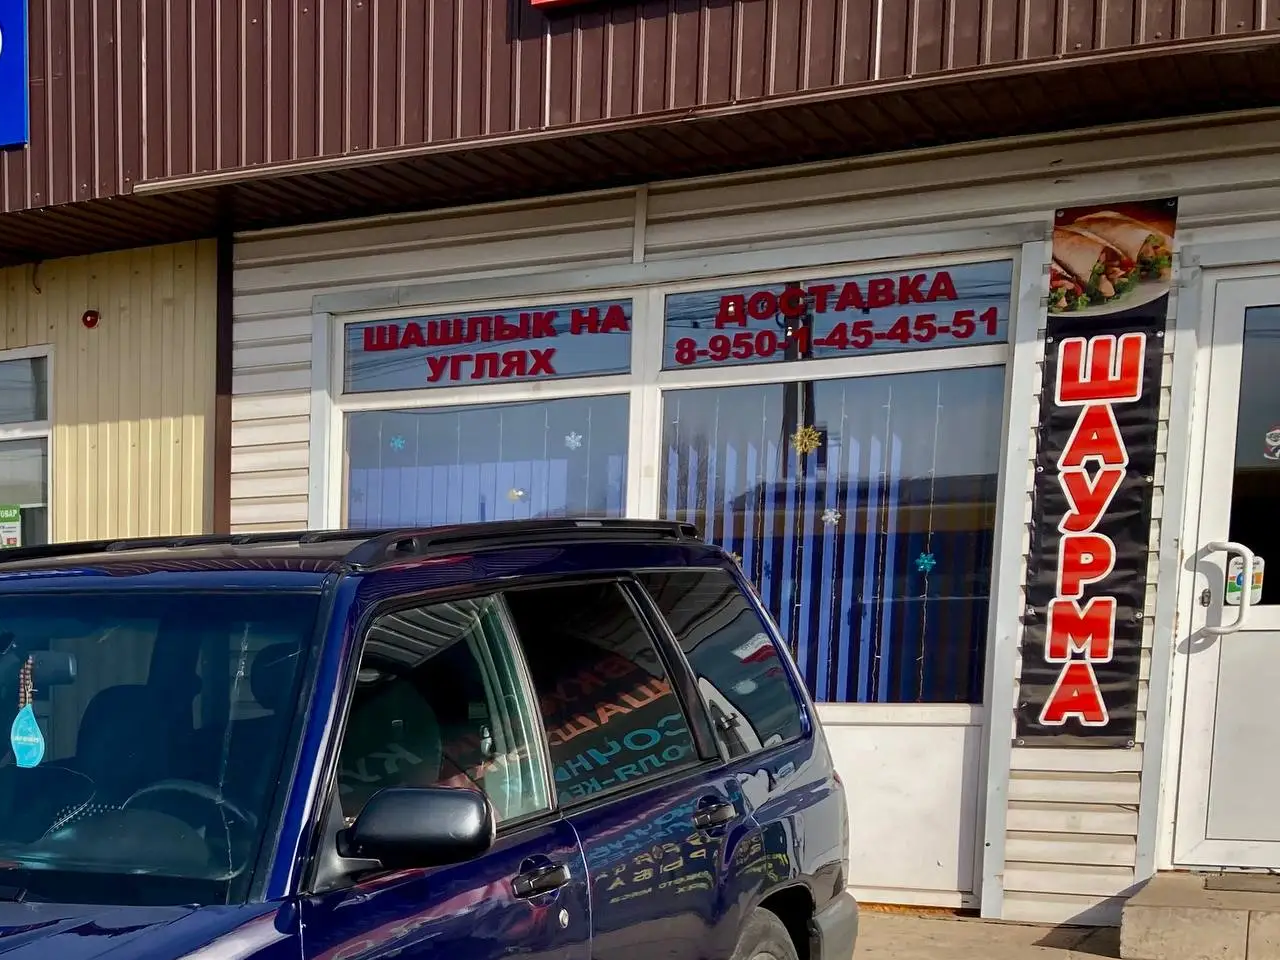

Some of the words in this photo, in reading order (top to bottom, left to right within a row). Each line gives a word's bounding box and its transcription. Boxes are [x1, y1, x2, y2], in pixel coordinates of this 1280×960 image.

[363, 311, 556, 352] ШАШЛЫК
[570, 304, 630, 335] НА
[715, 271, 958, 328] ДОСТАВКА
[674, 306, 998, 365] 8-950-1-45-45-51
[426, 348, 556, 382] УГЛЯХ
[1040, 333, 1147, 726] ШАУРМА
